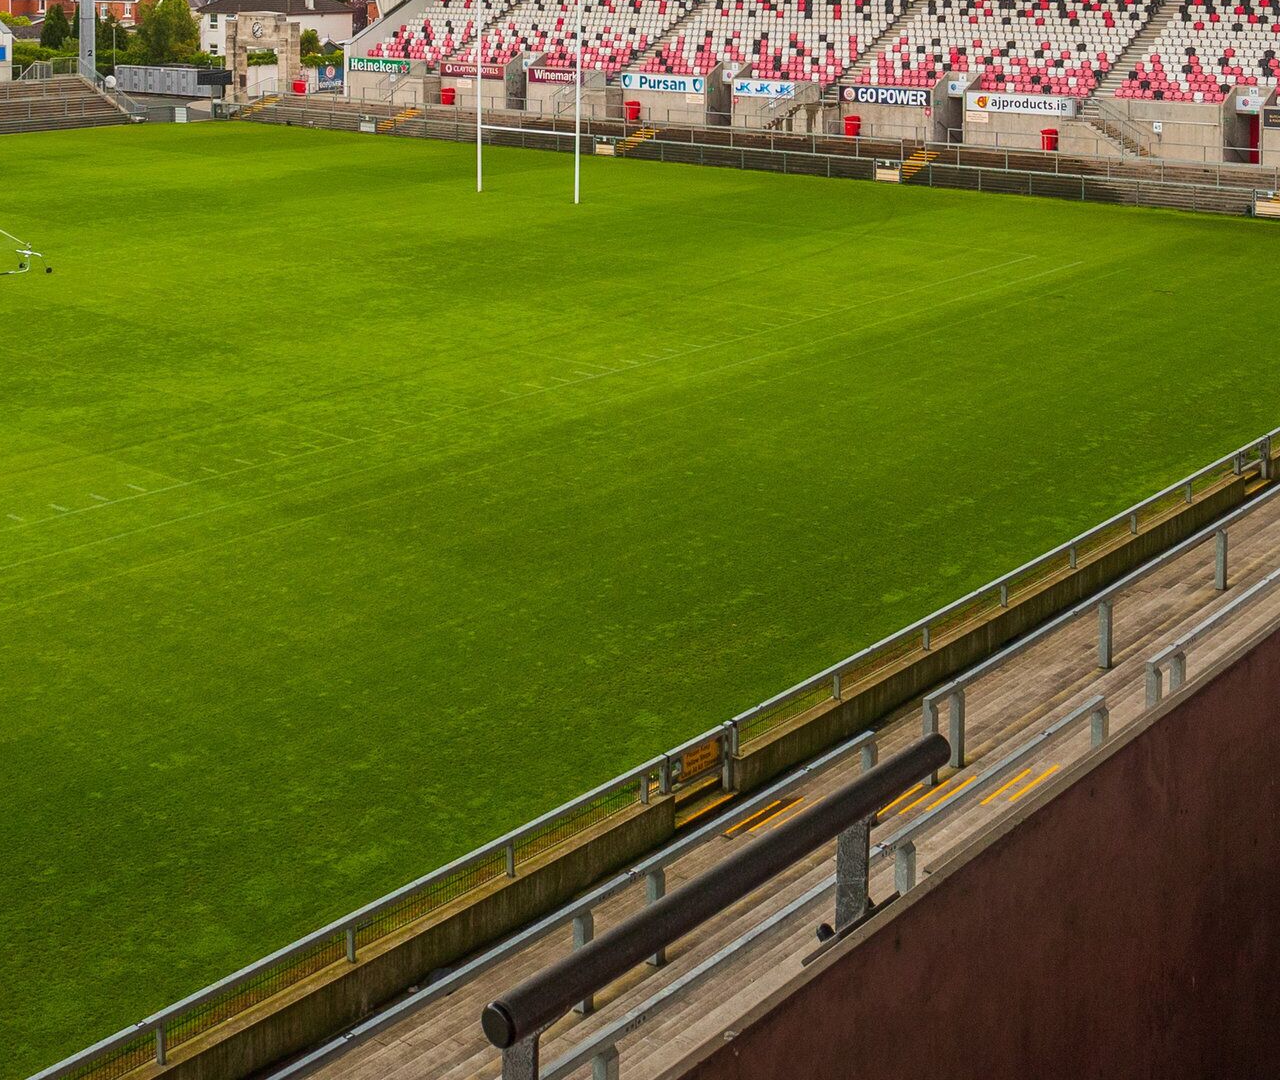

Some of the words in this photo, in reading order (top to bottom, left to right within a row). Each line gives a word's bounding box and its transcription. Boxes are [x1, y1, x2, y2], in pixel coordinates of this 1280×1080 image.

[87, 49, 93, 57] 2
[350, 59, 399, 73] Heineken
[453, 65, 477, 73] CLAYTON
[639, 75, 687, 91] Pursan
[857, 88, 876, 102] GO
[877, 89, 927, 106] POWER
[990, 97, 1068, 112] ajproducts.ie
